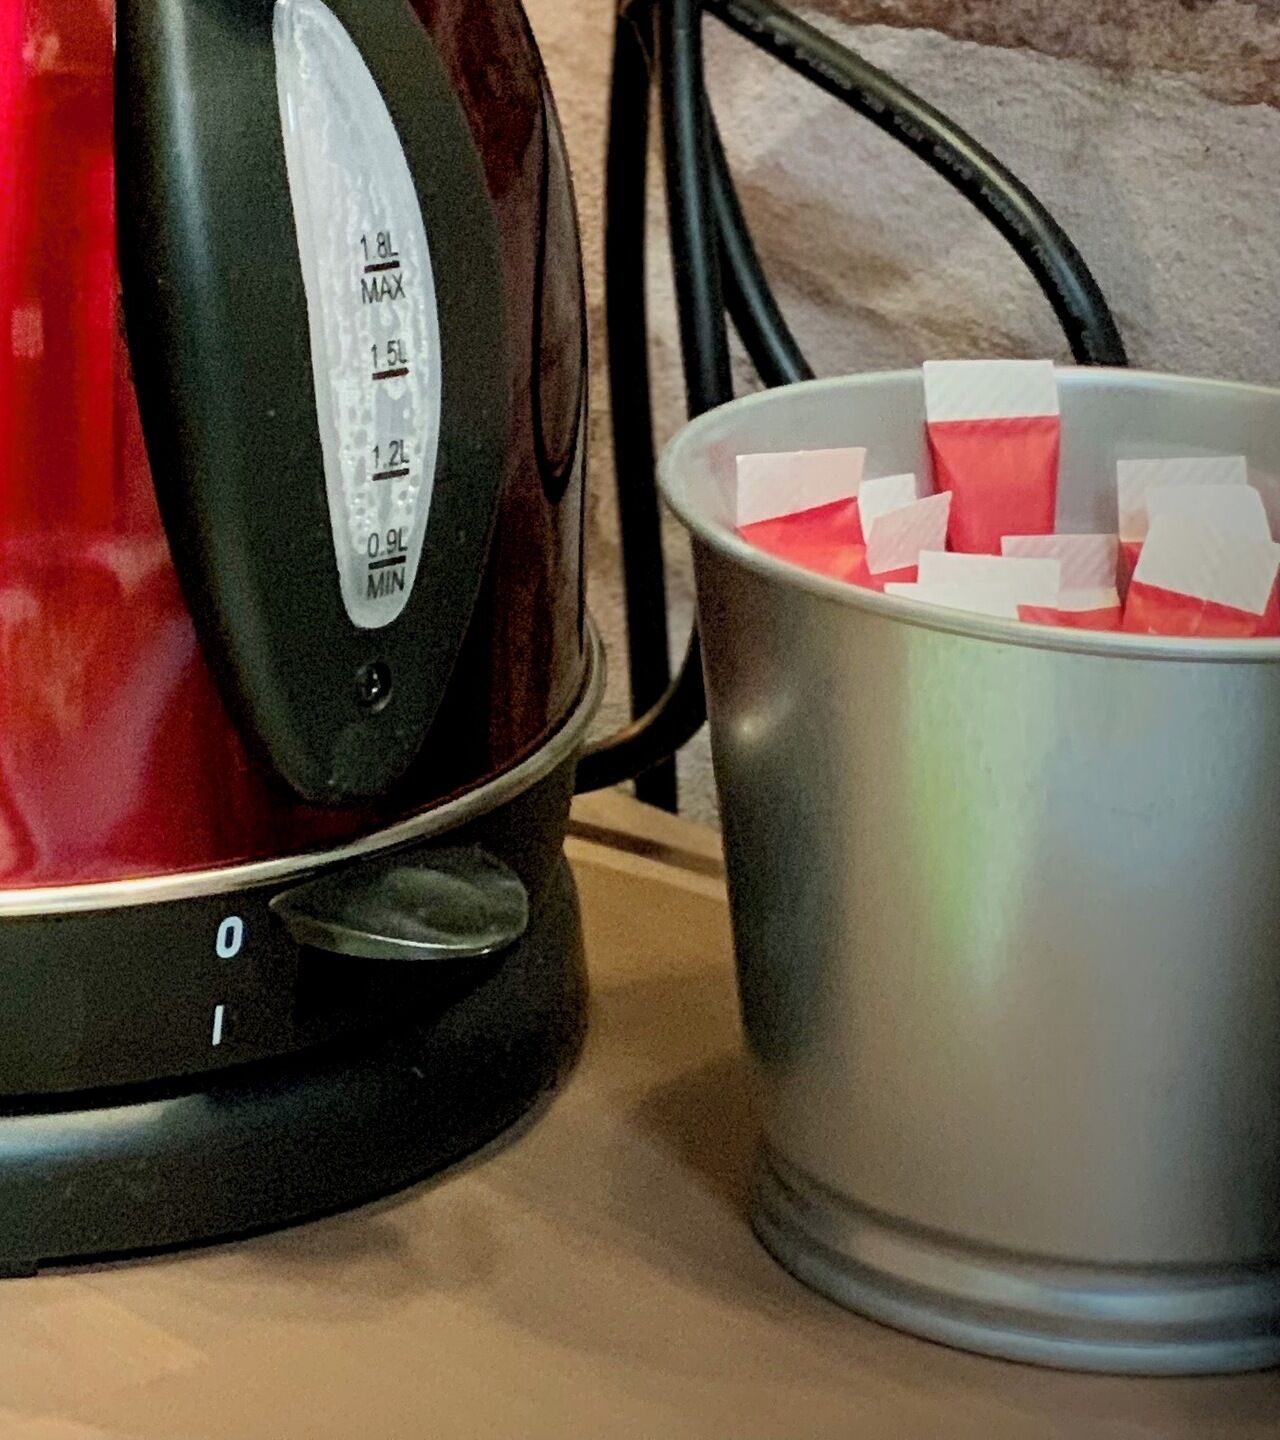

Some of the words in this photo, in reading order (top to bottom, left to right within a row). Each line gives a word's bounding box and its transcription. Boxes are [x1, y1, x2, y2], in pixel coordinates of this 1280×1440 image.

[360, 230, 399, 261] 1.8L
[360, 272, 406, 304] MAX
[371, 338, 409, 369] 1.5L
[372, 439, 410, 469] 1.2L
[367, 527, 408, 558] 0.9L
[367, 566, 405, 601] MIN
